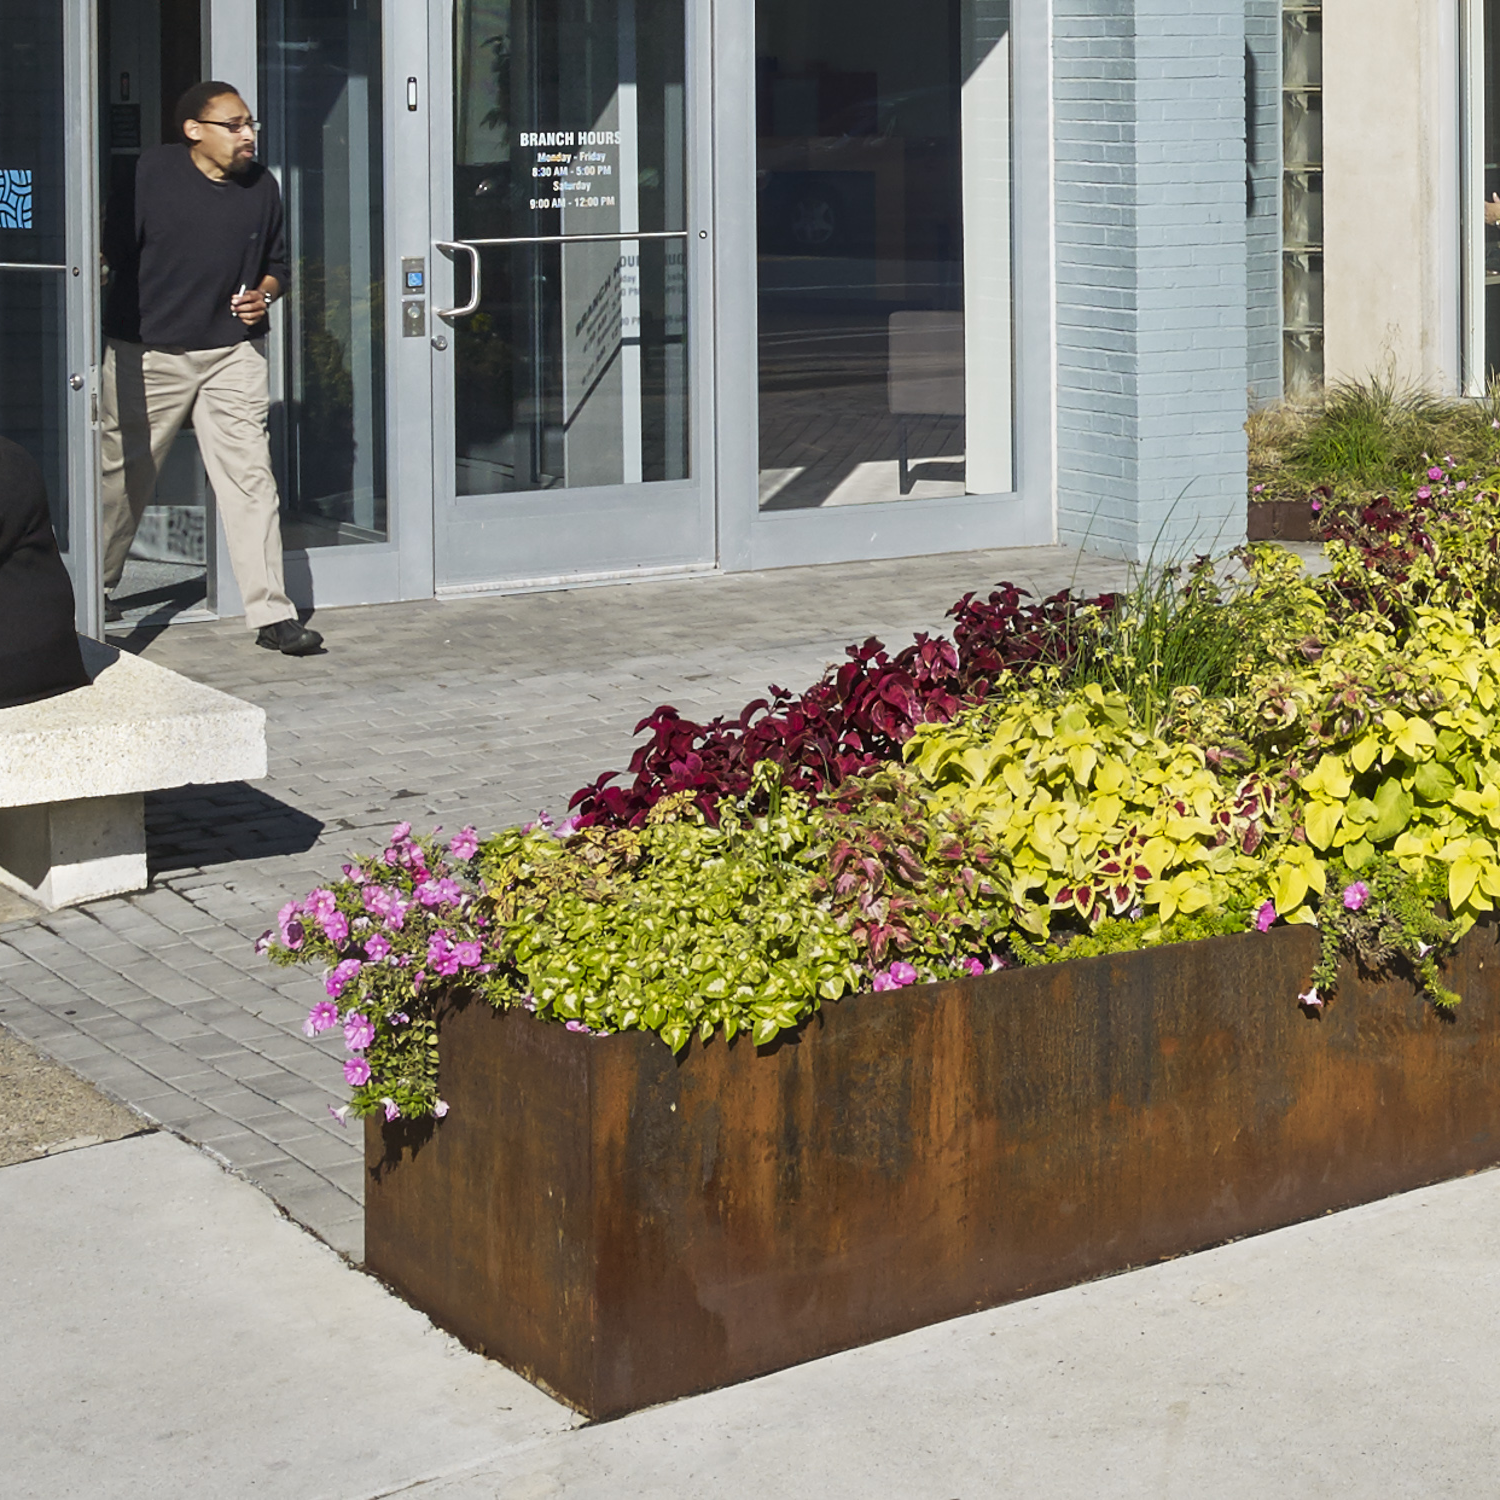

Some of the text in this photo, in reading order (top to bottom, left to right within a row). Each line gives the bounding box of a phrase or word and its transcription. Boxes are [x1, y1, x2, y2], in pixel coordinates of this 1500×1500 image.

[520, 131, 621, 147] BRANCH HOURS
[537, 152, 572, 163] Monday
[580, 151, 606, 162] Friday
[532, 167, 552, 177] 8:30
[553, 166, 568, 176] AM
[576, 166, 595, 176] 5:00
[597, 165, 612, 175] PM
[552, 180, 591, 192] Saturday
[529, 198, 550, 210] 9:00
[551, 197, 566, 208] AM
[574, 196, 599, 207] 12:00
[601, 196, 615, 206] PM
